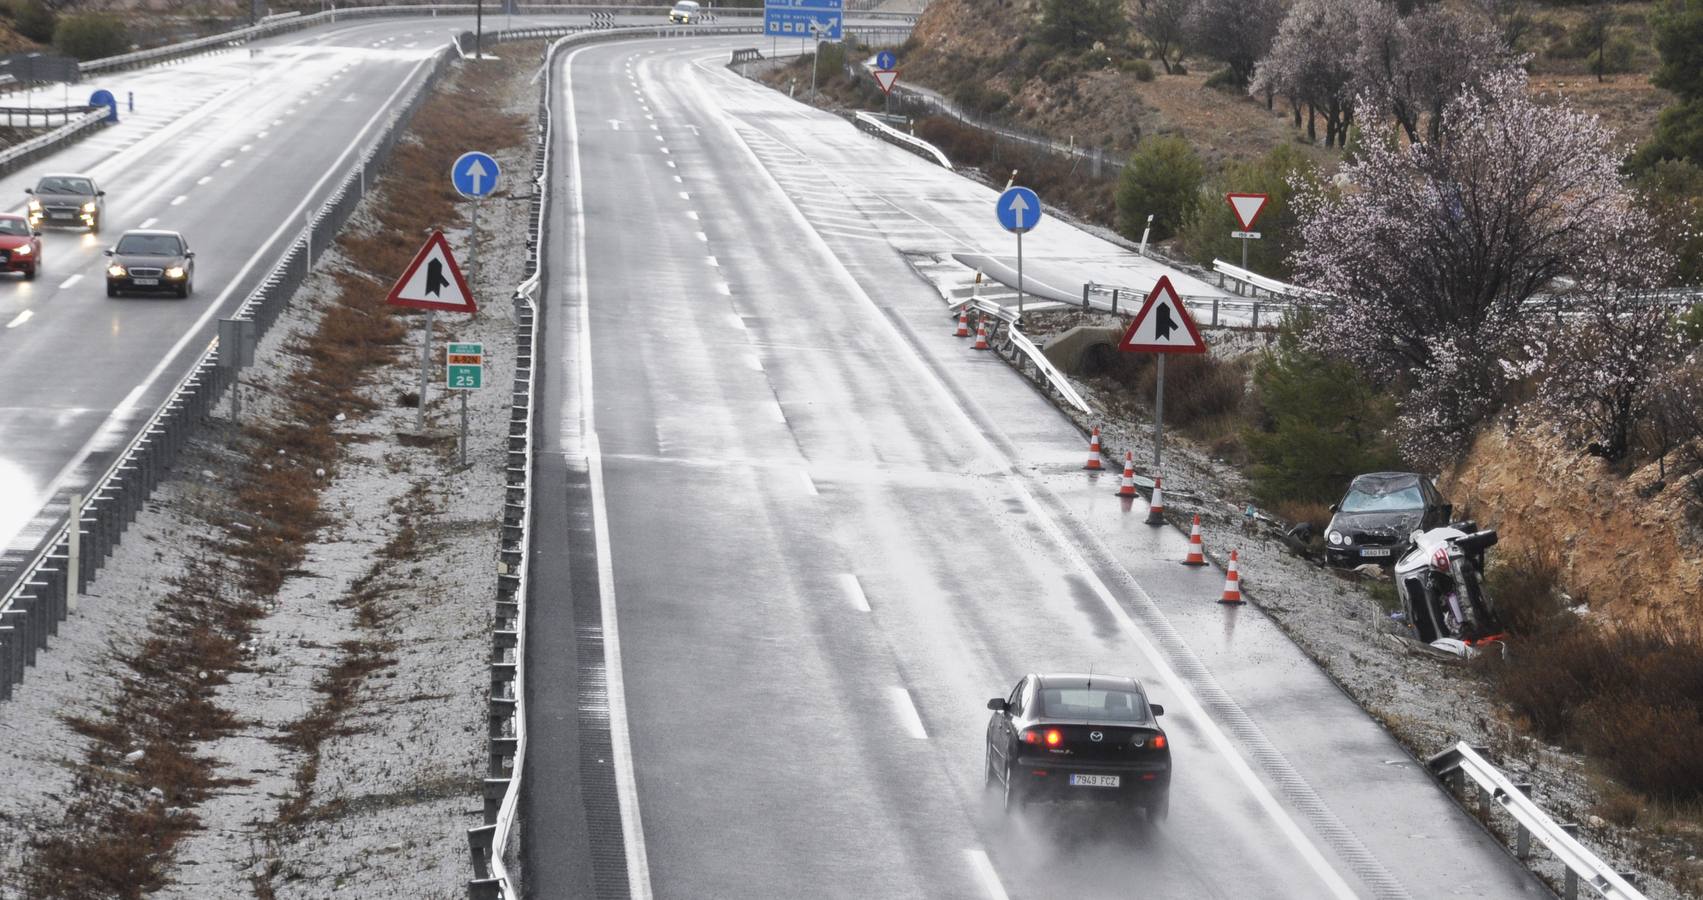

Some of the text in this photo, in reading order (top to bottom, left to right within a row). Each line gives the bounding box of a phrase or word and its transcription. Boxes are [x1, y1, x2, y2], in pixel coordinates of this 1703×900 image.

[453, 355, 479, 364] A-92N
[456, 375, 474, 386] 25
[1076, 775, 1116, 786] 7949 FCZ
